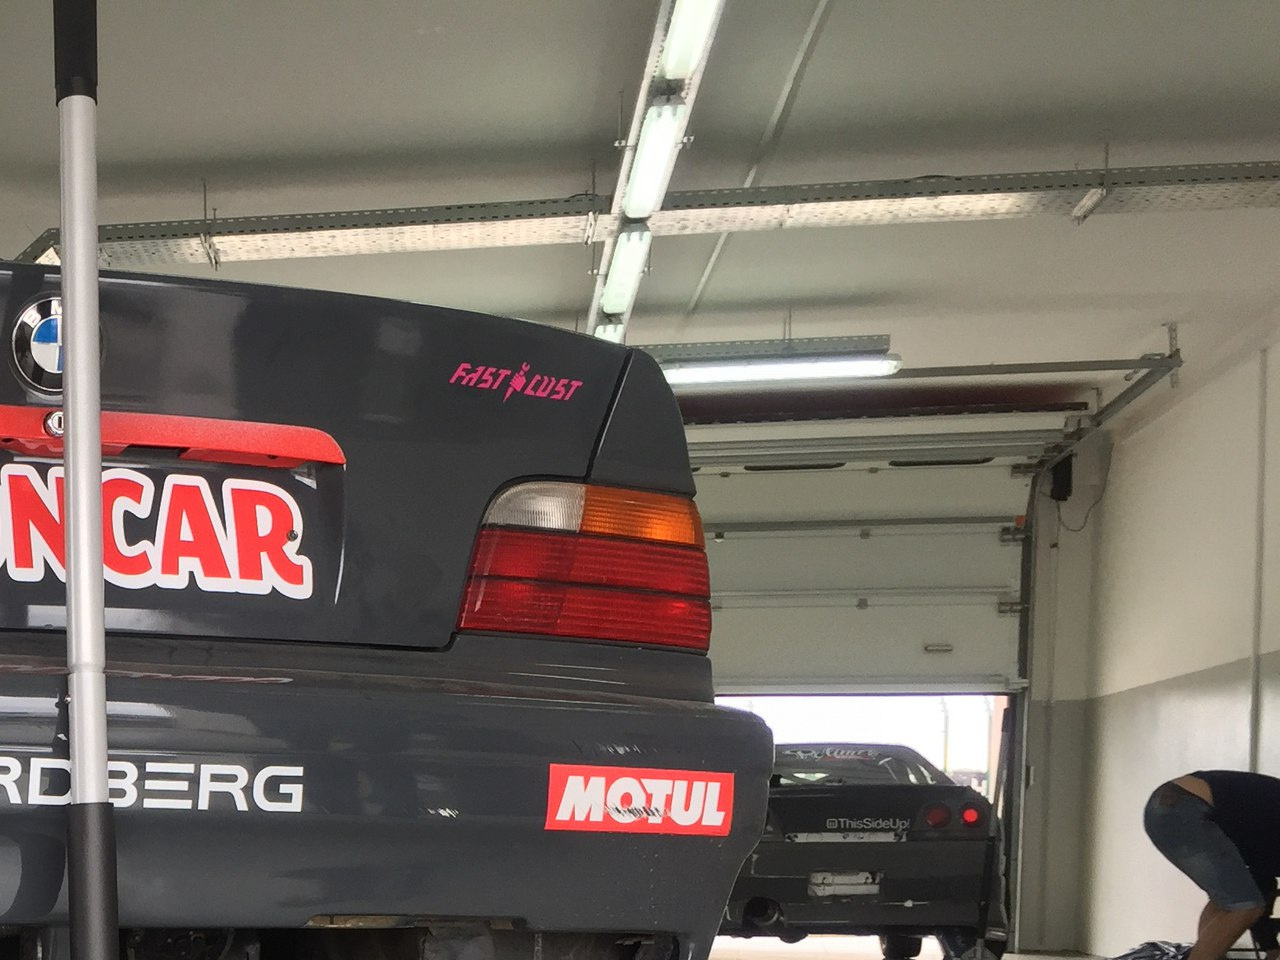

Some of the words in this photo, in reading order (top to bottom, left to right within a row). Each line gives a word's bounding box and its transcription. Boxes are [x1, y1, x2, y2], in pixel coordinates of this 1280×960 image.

[449, 362, 511, 389] FAST
[523, 373, 583, 400] LUST
[555, 775, 725, 826] MOTUL
